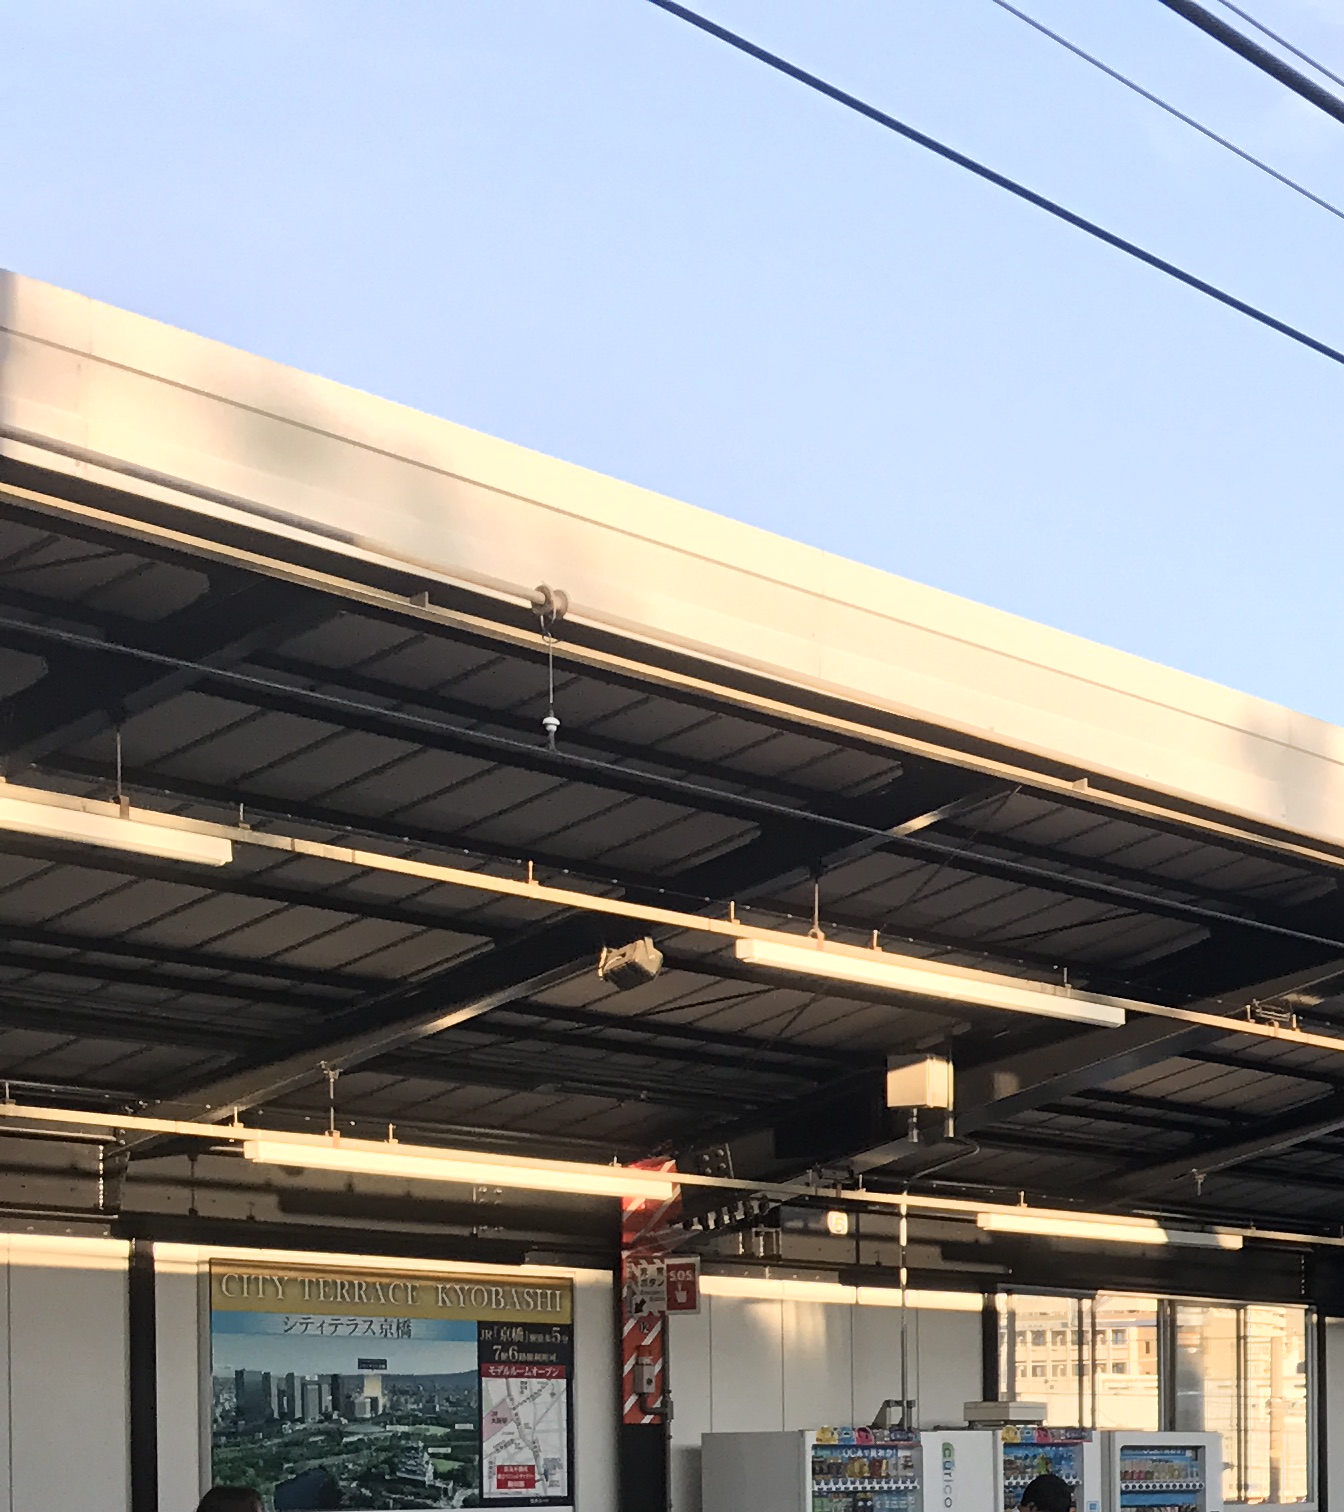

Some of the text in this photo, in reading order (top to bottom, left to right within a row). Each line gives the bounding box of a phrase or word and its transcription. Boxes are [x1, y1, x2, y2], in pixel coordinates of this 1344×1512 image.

[221, 1273, 563, 1312] CITY TERRACE KYOBASHI
[283, 1316, 412, 1339] シティテラス京橋
